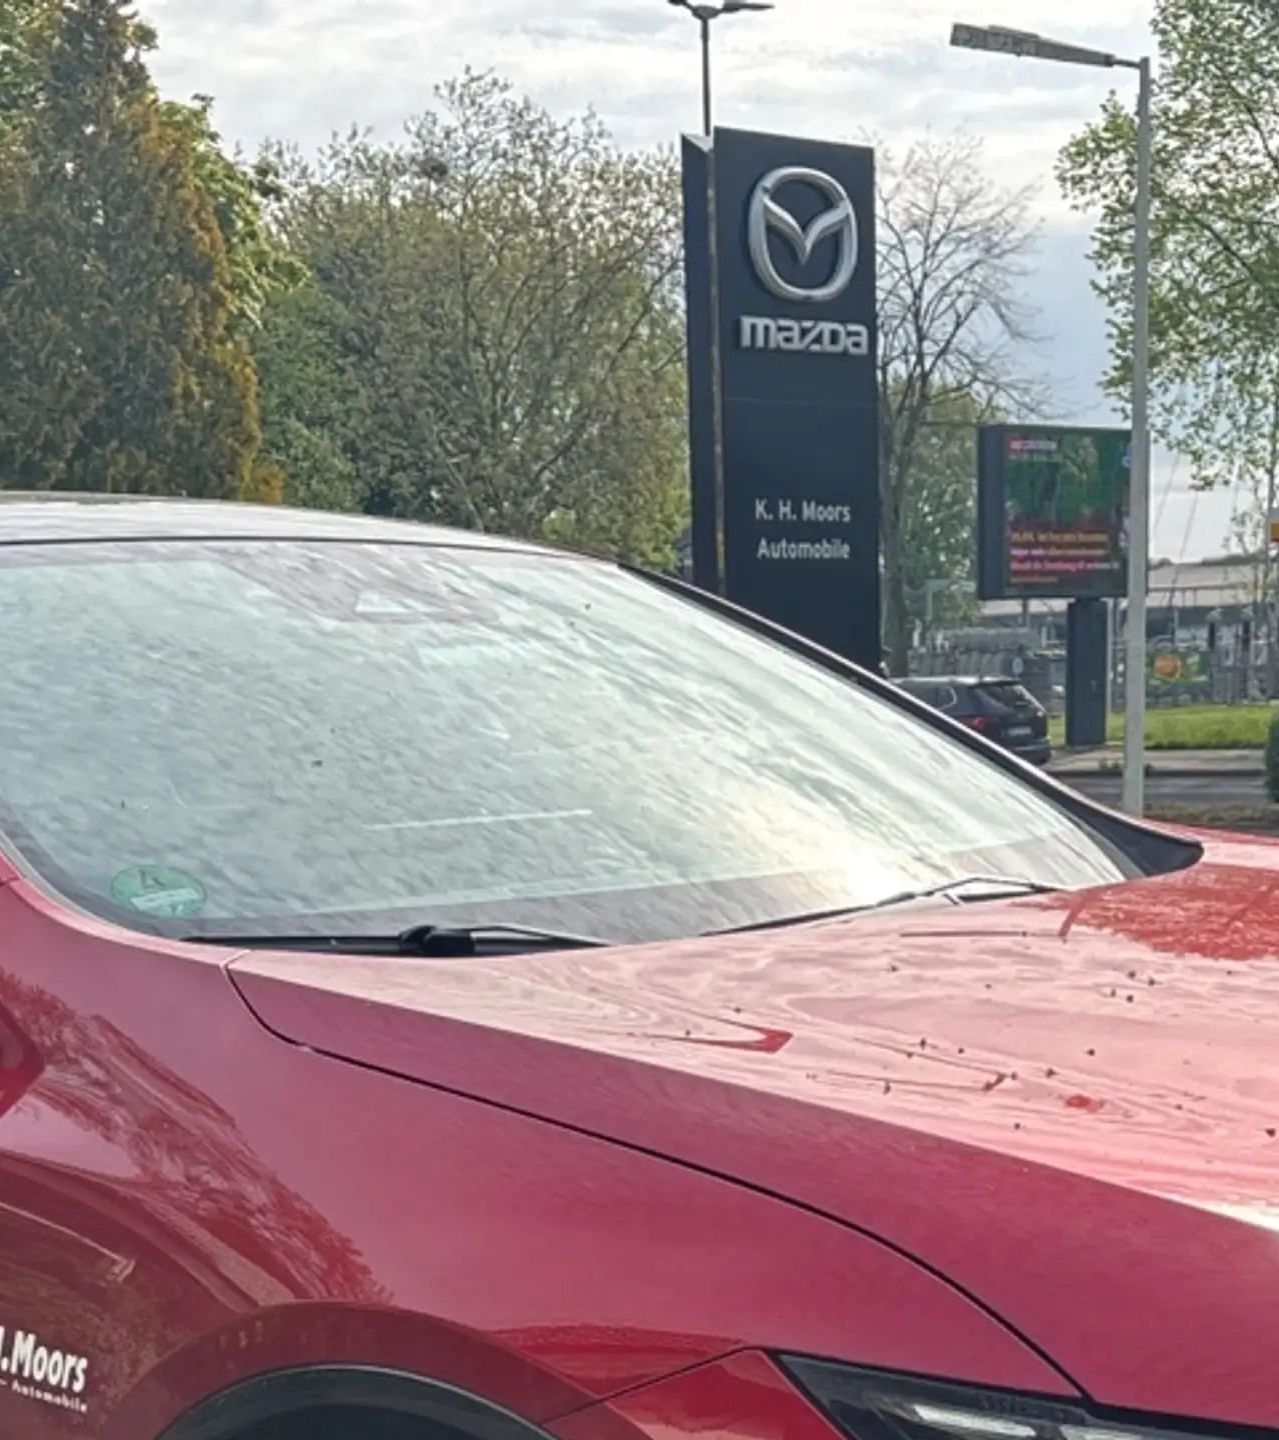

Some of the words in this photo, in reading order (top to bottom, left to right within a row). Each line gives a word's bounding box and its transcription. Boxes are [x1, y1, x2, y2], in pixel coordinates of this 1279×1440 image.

[755, 498, 773, 520] K.
[778, 499, 796, 520] H.
[802, 500, 851, 522] Moors
[757, 538, 850, 559] Automobile
[11, 1379, 88, 1414] Automobile
